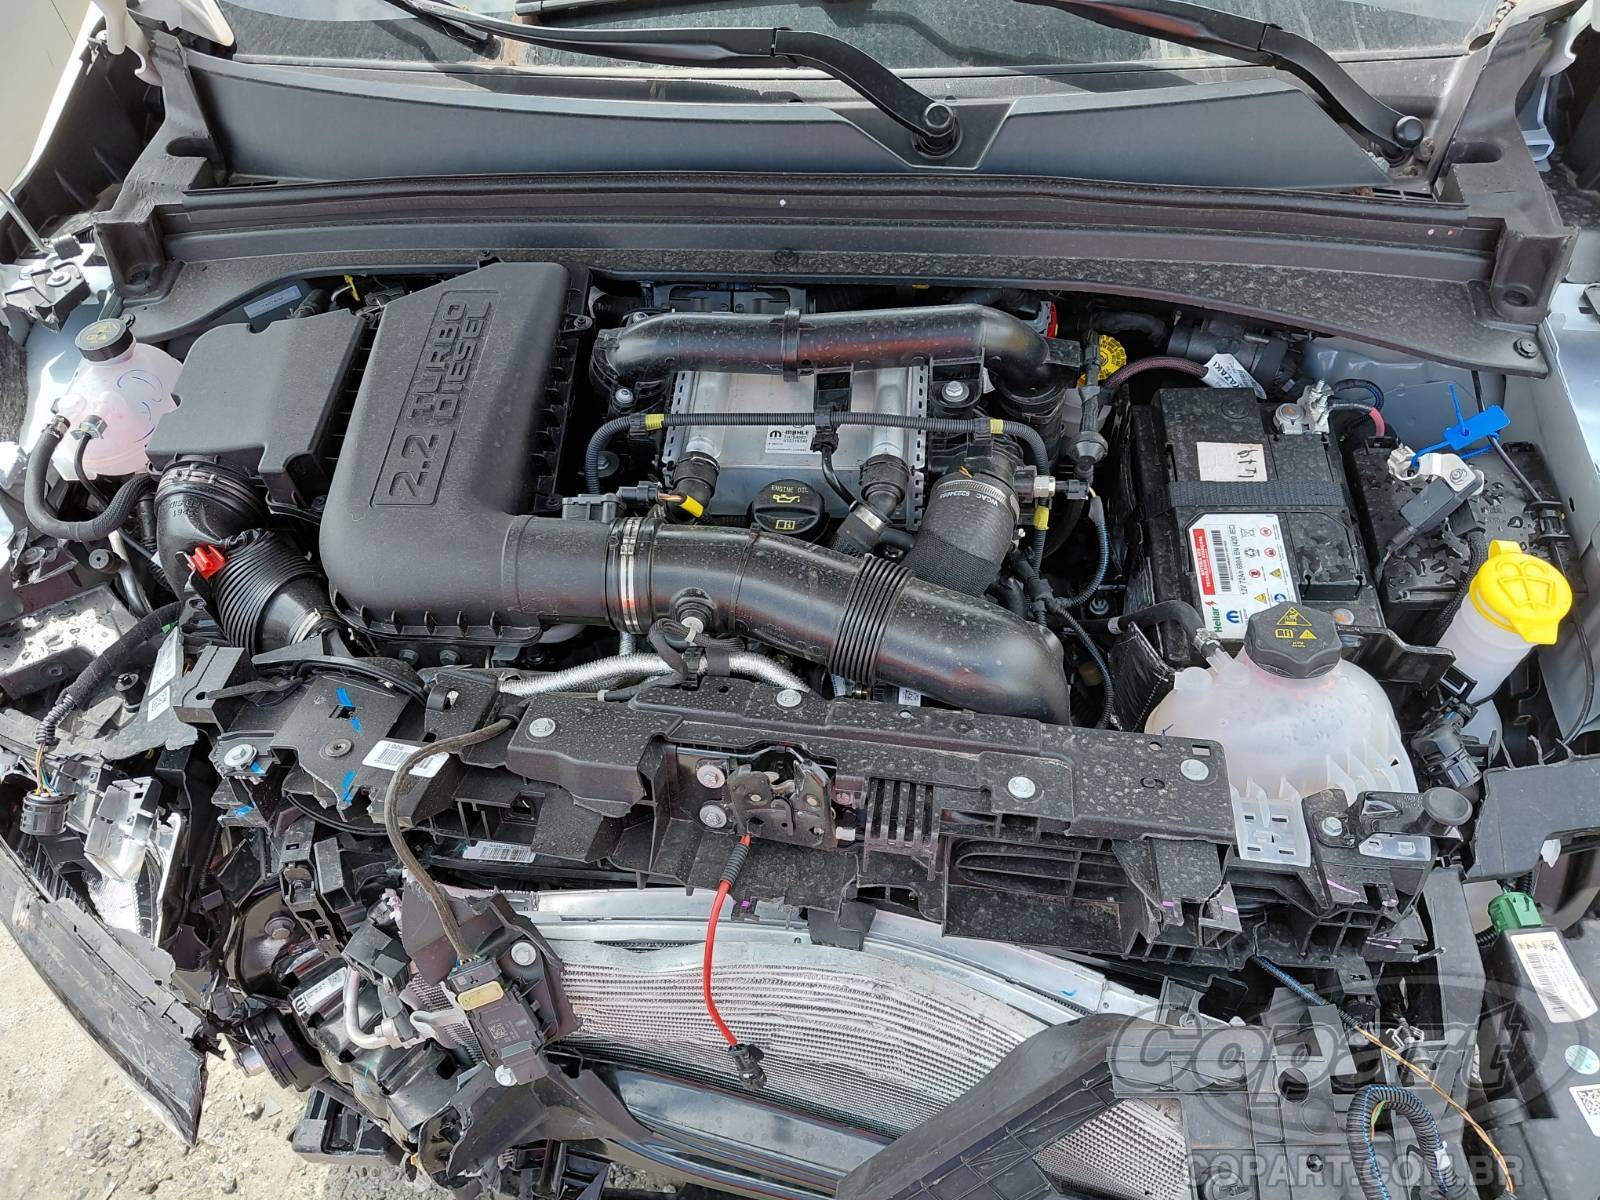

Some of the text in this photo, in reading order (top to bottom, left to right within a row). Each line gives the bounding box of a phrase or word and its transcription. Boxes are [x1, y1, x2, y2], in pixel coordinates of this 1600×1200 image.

[408, 303, 468, 419] TURBO
[433, 301, 492, 420] DIESEL
[388, 434, 440, 498] 2.2
[771, 484, 794, 493] ENGINE
[976, 493, 999, 507] WCAC
[1212, 606, 1222, 633] Heliar
